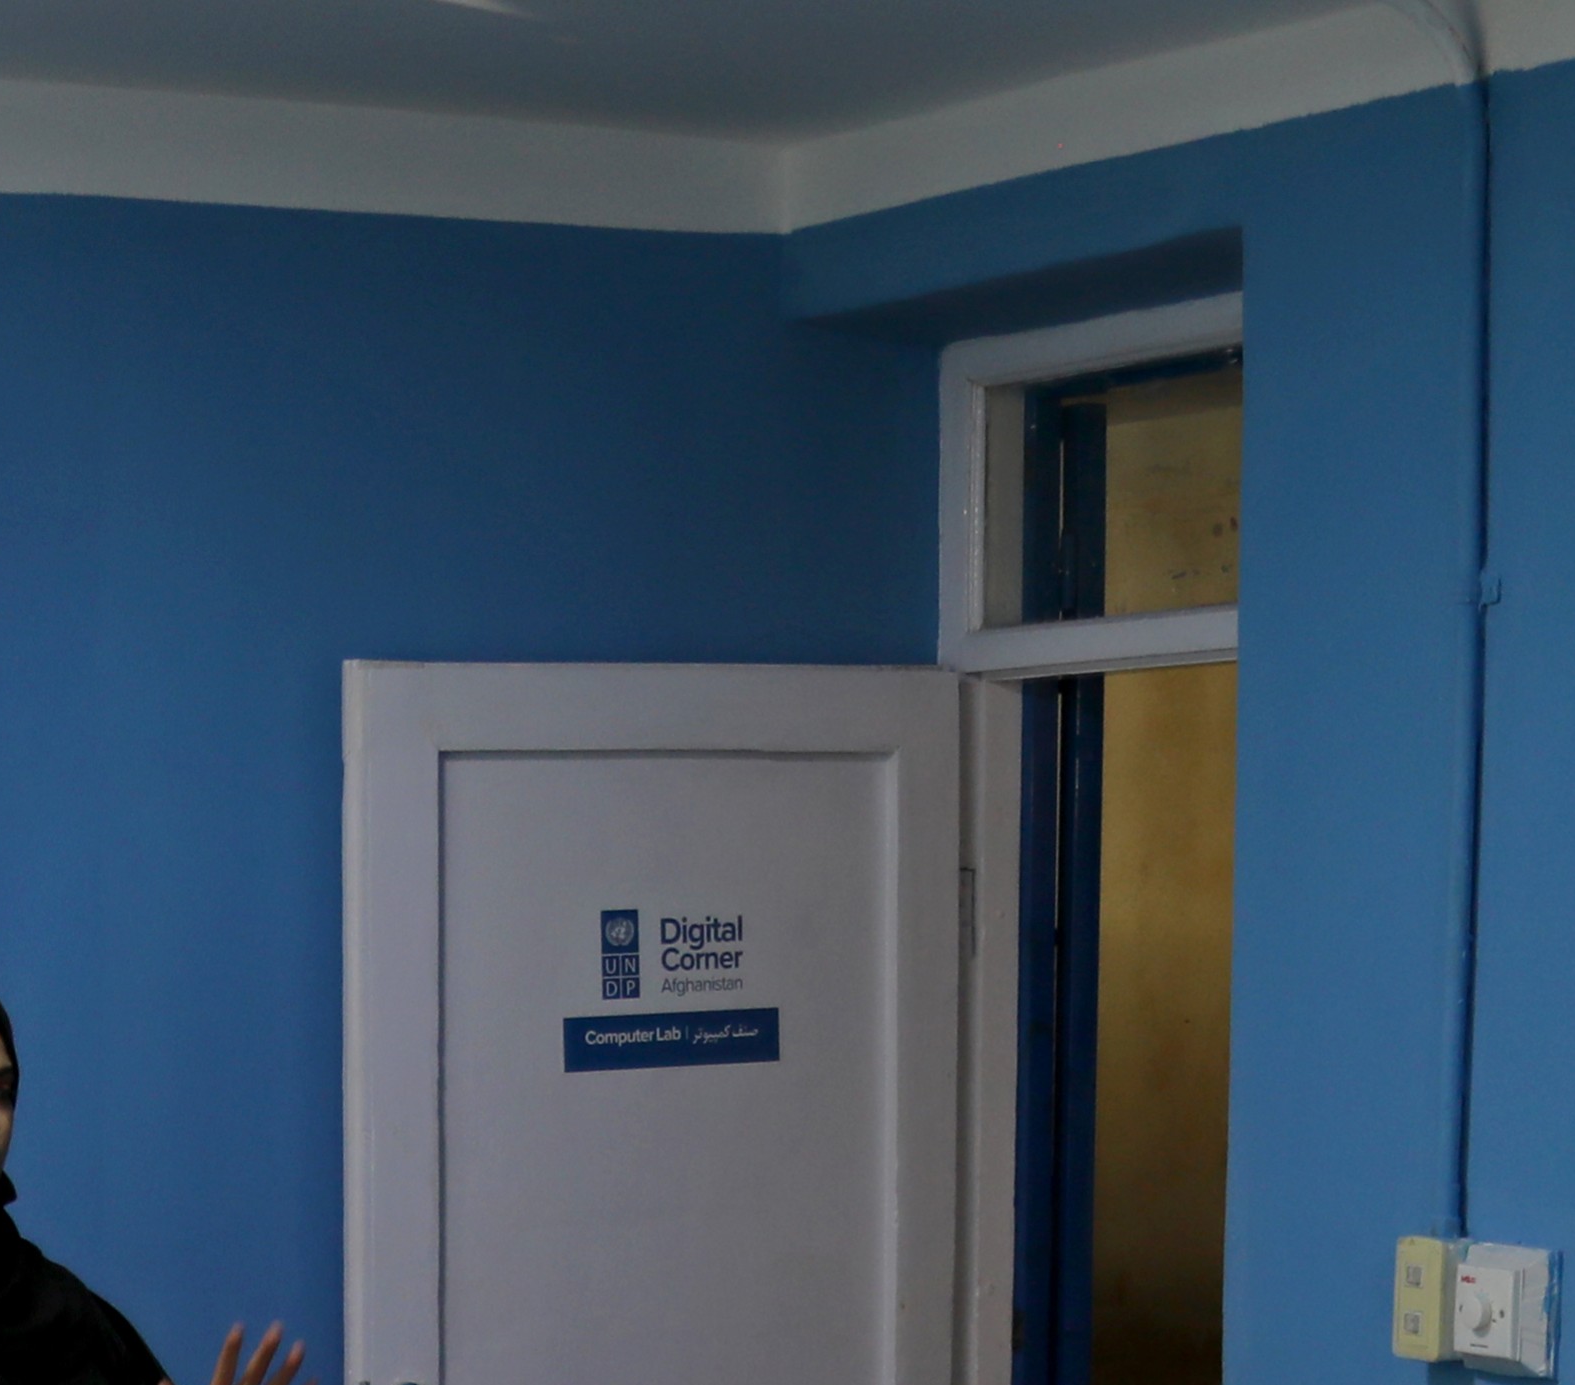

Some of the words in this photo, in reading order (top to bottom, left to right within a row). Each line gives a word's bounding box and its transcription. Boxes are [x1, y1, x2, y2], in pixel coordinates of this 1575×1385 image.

[660, 915, 743, 949] Digital
[661, 947, 743, 971] Corner
[661, 977, 743, 997] Afghanistan
[585, 1028, 654, 1047] Computer
[656, 1026, 682, 1043] Lab
